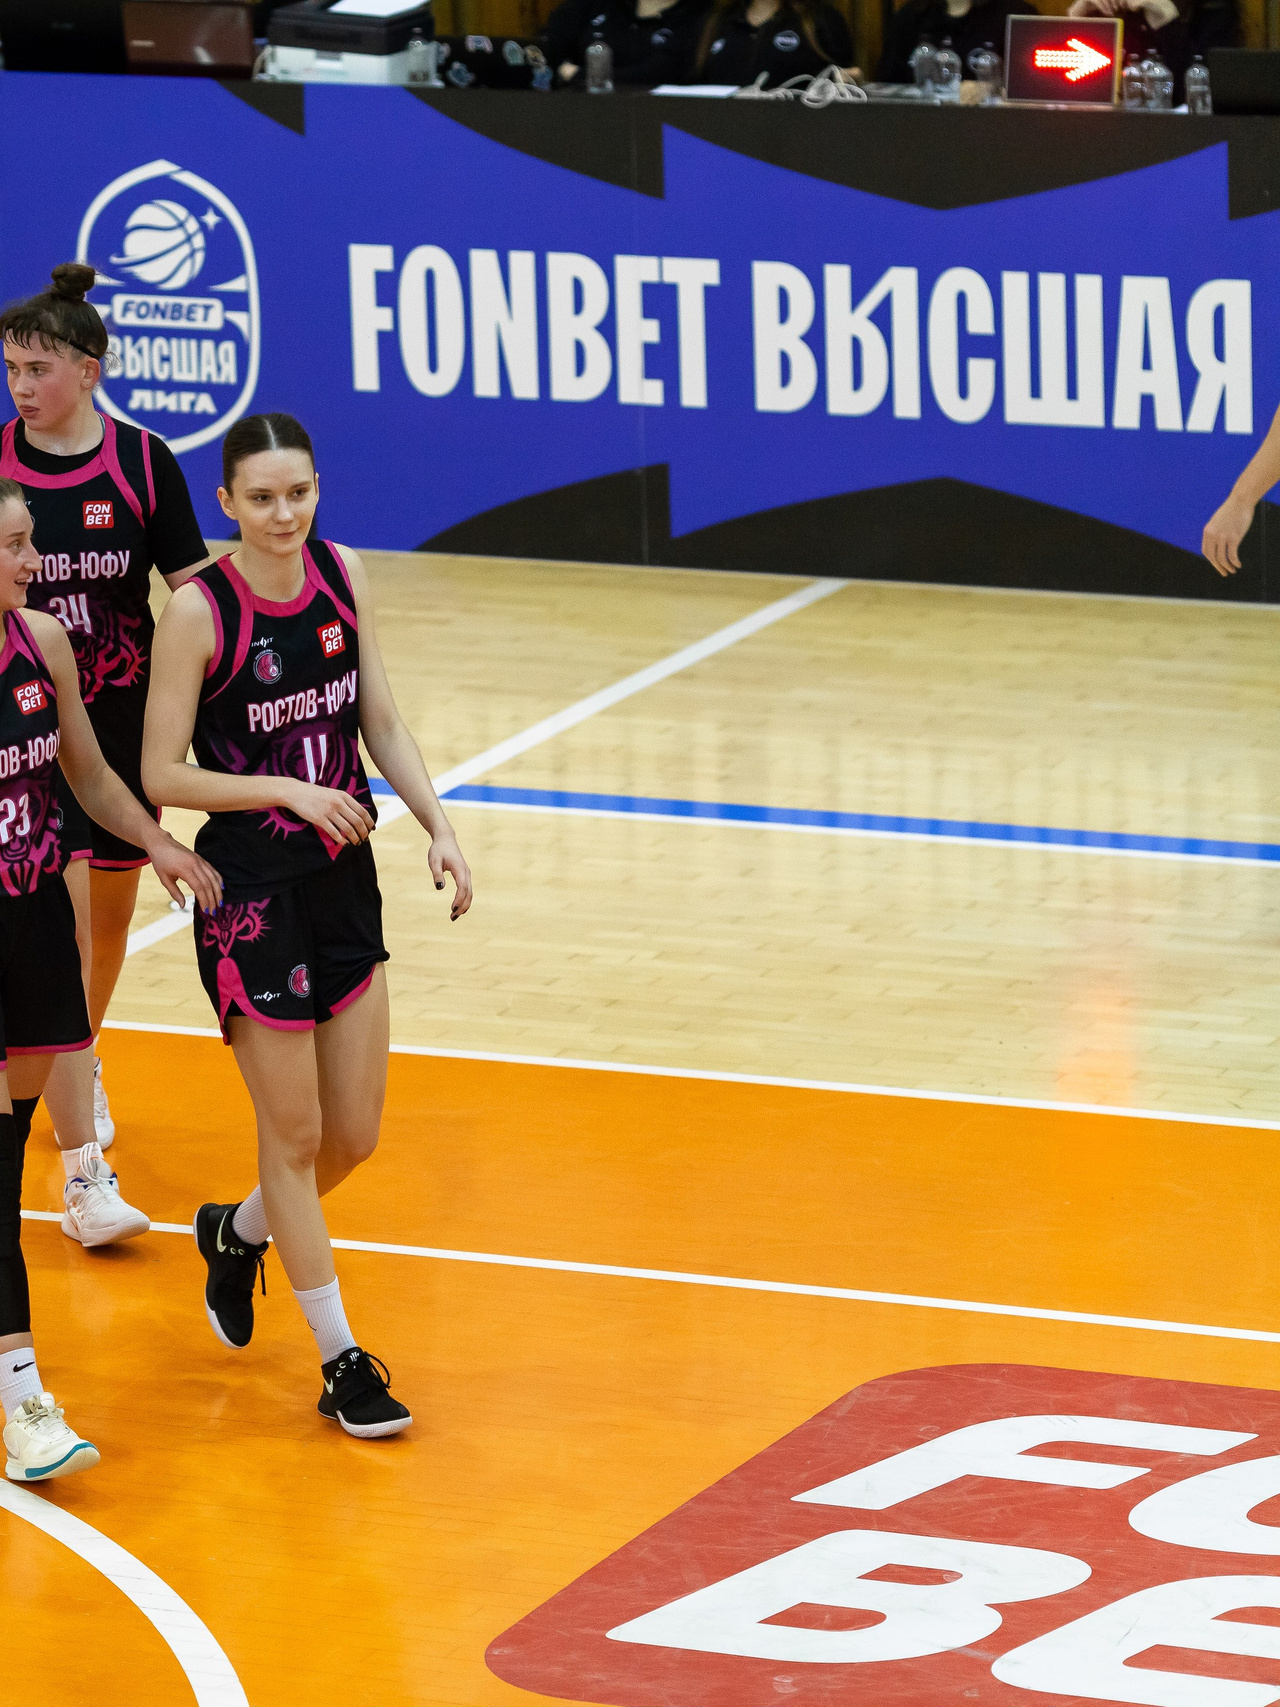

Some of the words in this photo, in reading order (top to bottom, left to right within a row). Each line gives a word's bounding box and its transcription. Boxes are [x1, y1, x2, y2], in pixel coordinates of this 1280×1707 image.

[121, 301, 215, 322] FONBET
[349, 243, 721, 409] FONBET
[751, 260, 1254, 435] ВЫСШАЯ
[105, 334, 238, 385] ВЫСШАЯ
[128, 388, 218, 415] ЛИГА
[85, 504, 111, 514] FON
[85, 514, 111, 526] BET
[321, 622, 341, 642] FON
[325, 634, 344, 653] BET
[16, 683, 39, 701] FON
[247, 670, 358, 733] РОСТОВ-ЮФУ
[21, 693, 43, 712] BET
